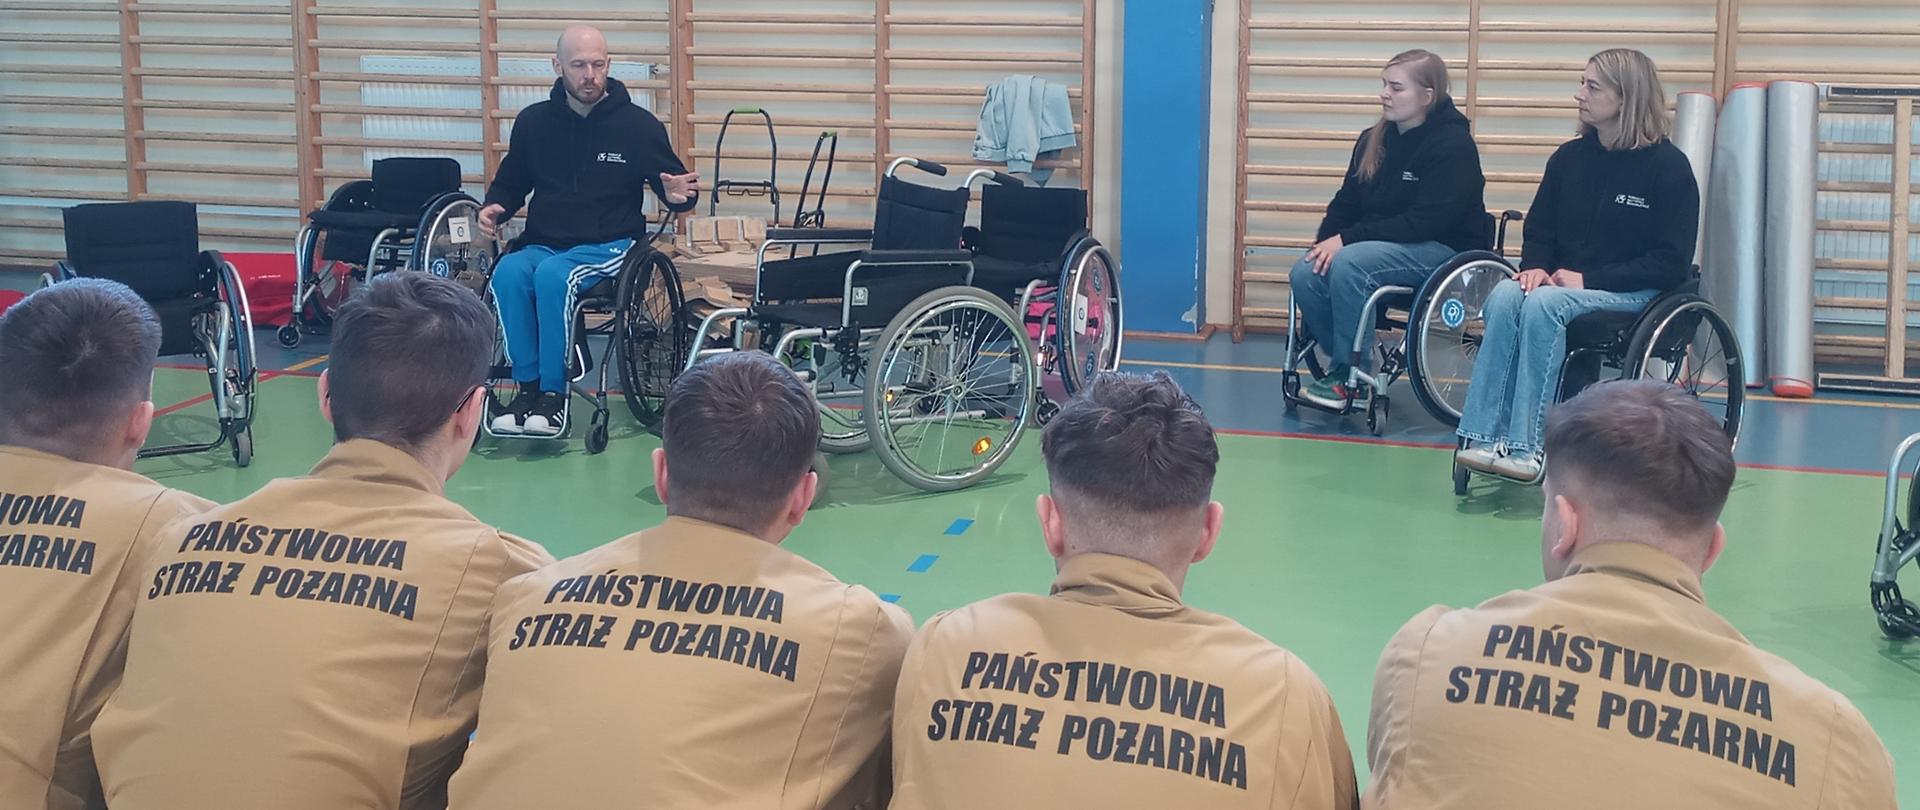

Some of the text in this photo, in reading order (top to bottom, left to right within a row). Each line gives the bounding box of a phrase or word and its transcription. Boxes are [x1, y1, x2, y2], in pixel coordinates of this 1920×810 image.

[178, 518, 407, 571] PAŃSTWOWA
[544, 569, 784, 624] PAŃSTWOWA
[961, 651, 1226, 729] PAŃSTWOWA
[1484, 625, 1773, 722] PAŃSTWOWA
